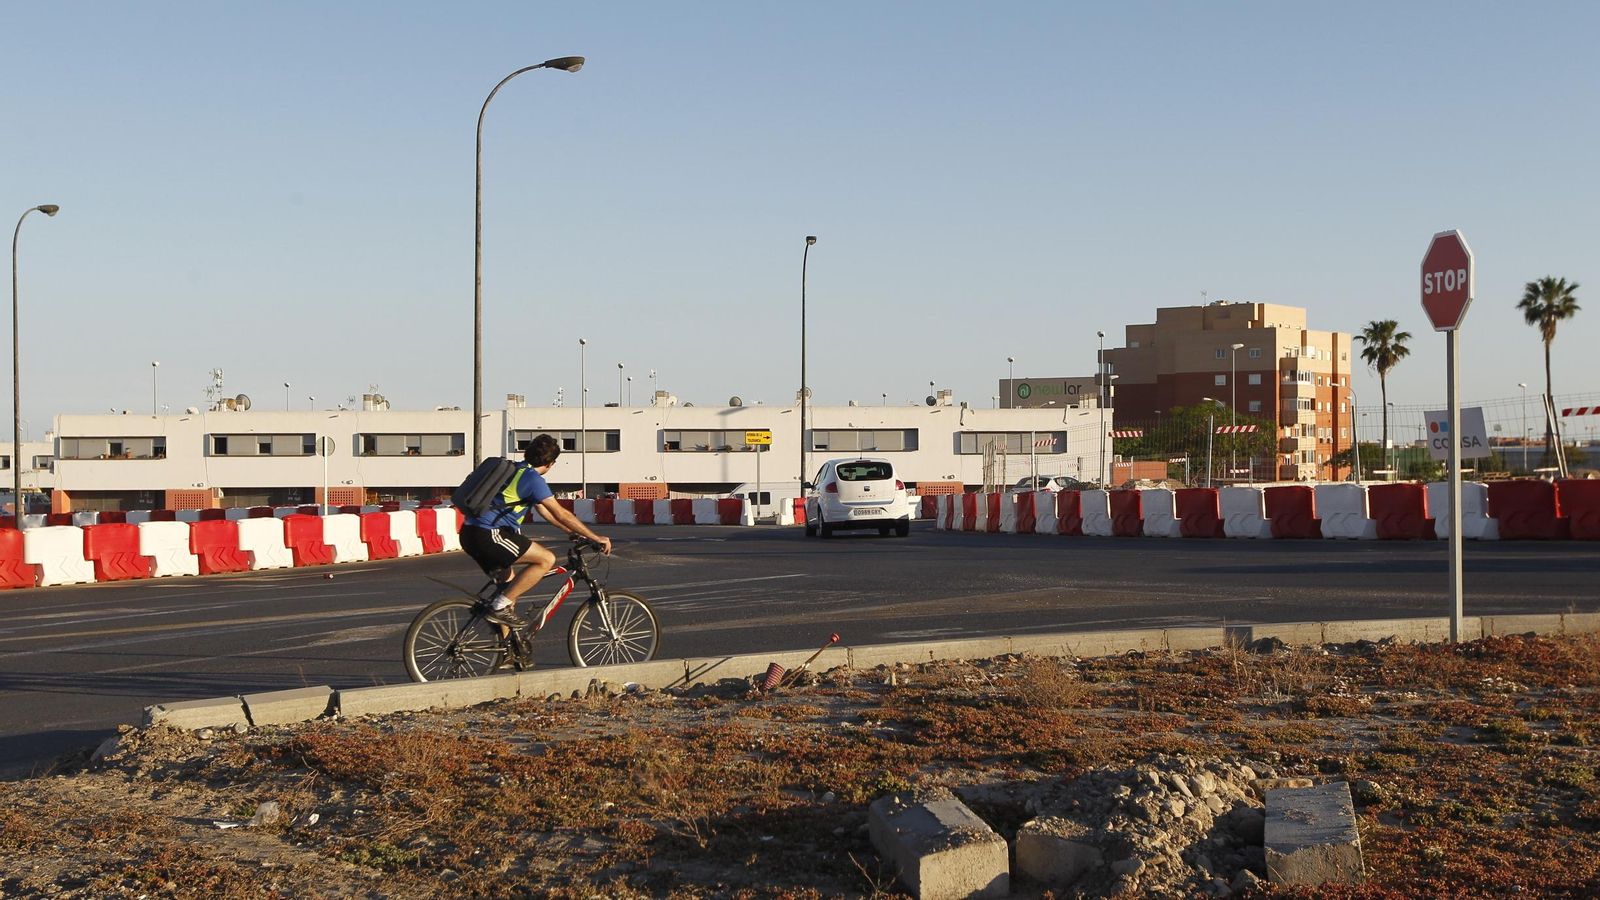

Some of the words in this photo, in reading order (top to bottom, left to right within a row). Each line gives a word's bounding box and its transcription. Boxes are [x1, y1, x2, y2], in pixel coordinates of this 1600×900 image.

[1424, 269, 1466, 294] STOP
[1035, 382, 1082, 395] newlar
[1433, 436, 1481, 449] COSA
